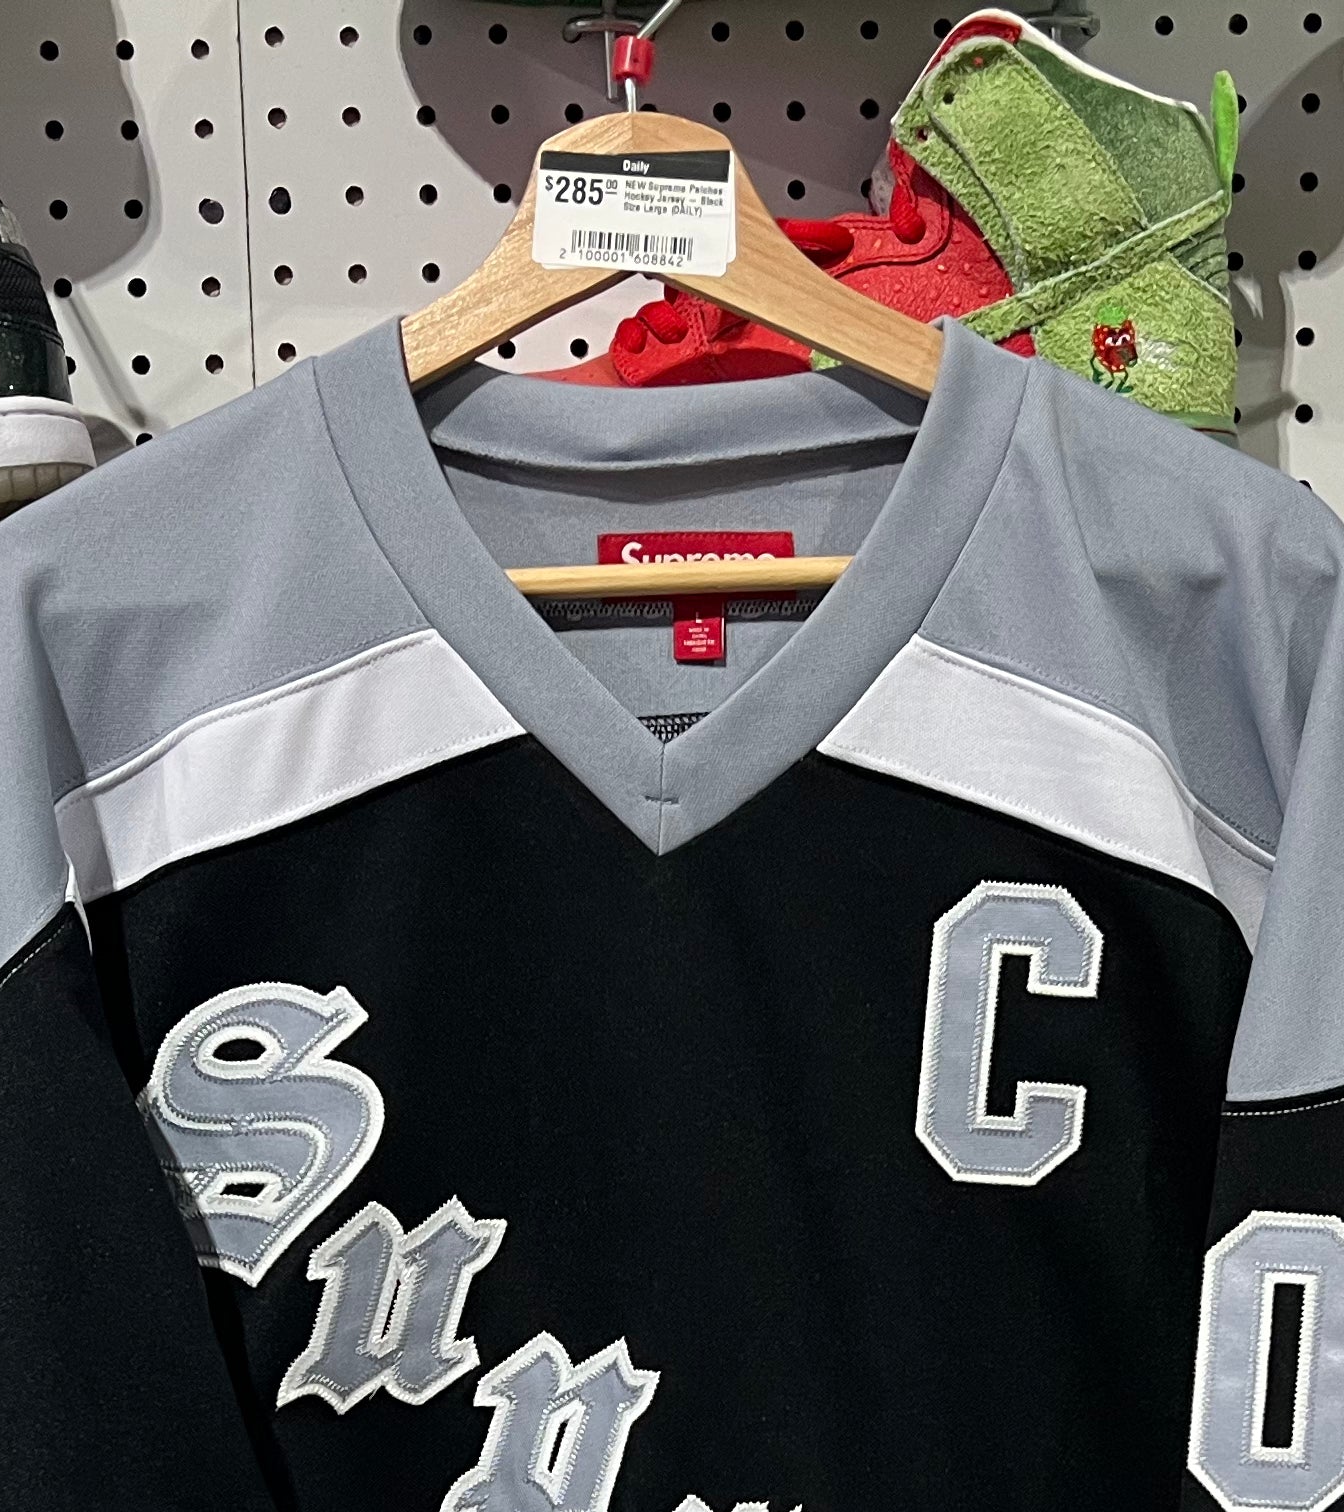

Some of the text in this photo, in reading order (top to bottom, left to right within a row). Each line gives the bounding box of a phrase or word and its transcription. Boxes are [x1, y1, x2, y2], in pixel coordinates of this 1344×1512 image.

[623, 159, 650, 175] Daily
[625, 180, 723, 195] NEW Supreme Patches
[624, 191, 655, 203] Hockey
[657, 193, 685, 206] Jersey
[701, 196, 723, 207] Black
[624, 202, 702, 218] Size Large (DAILY)
[578, 250, 626, 263] 100001
[634, 253, 684, 268] 608842
[915, 880, 1104, 1186] C
